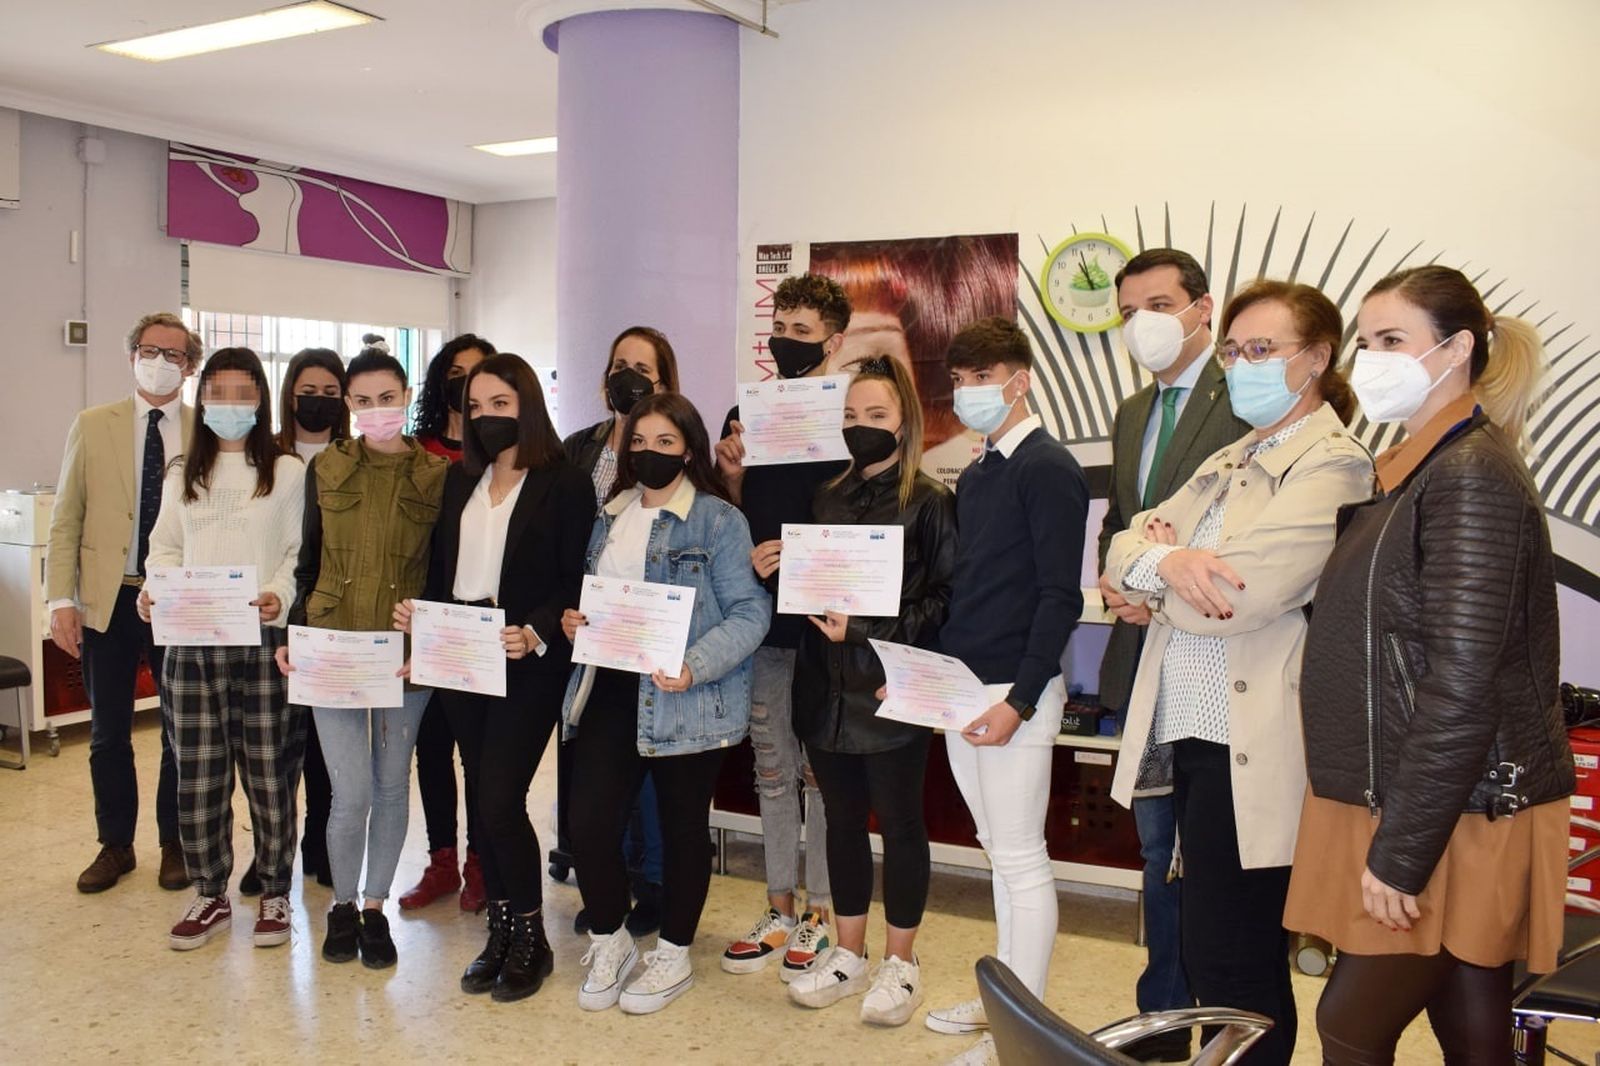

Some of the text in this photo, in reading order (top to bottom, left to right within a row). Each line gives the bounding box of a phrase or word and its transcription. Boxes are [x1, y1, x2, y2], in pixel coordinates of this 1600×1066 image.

[1087, 243, 1096, 251] 12
[1057, 261, 1066, 270] 10
[1105, 308, 1110, 316] 5
[1088, 313, 1093, 321] 6
